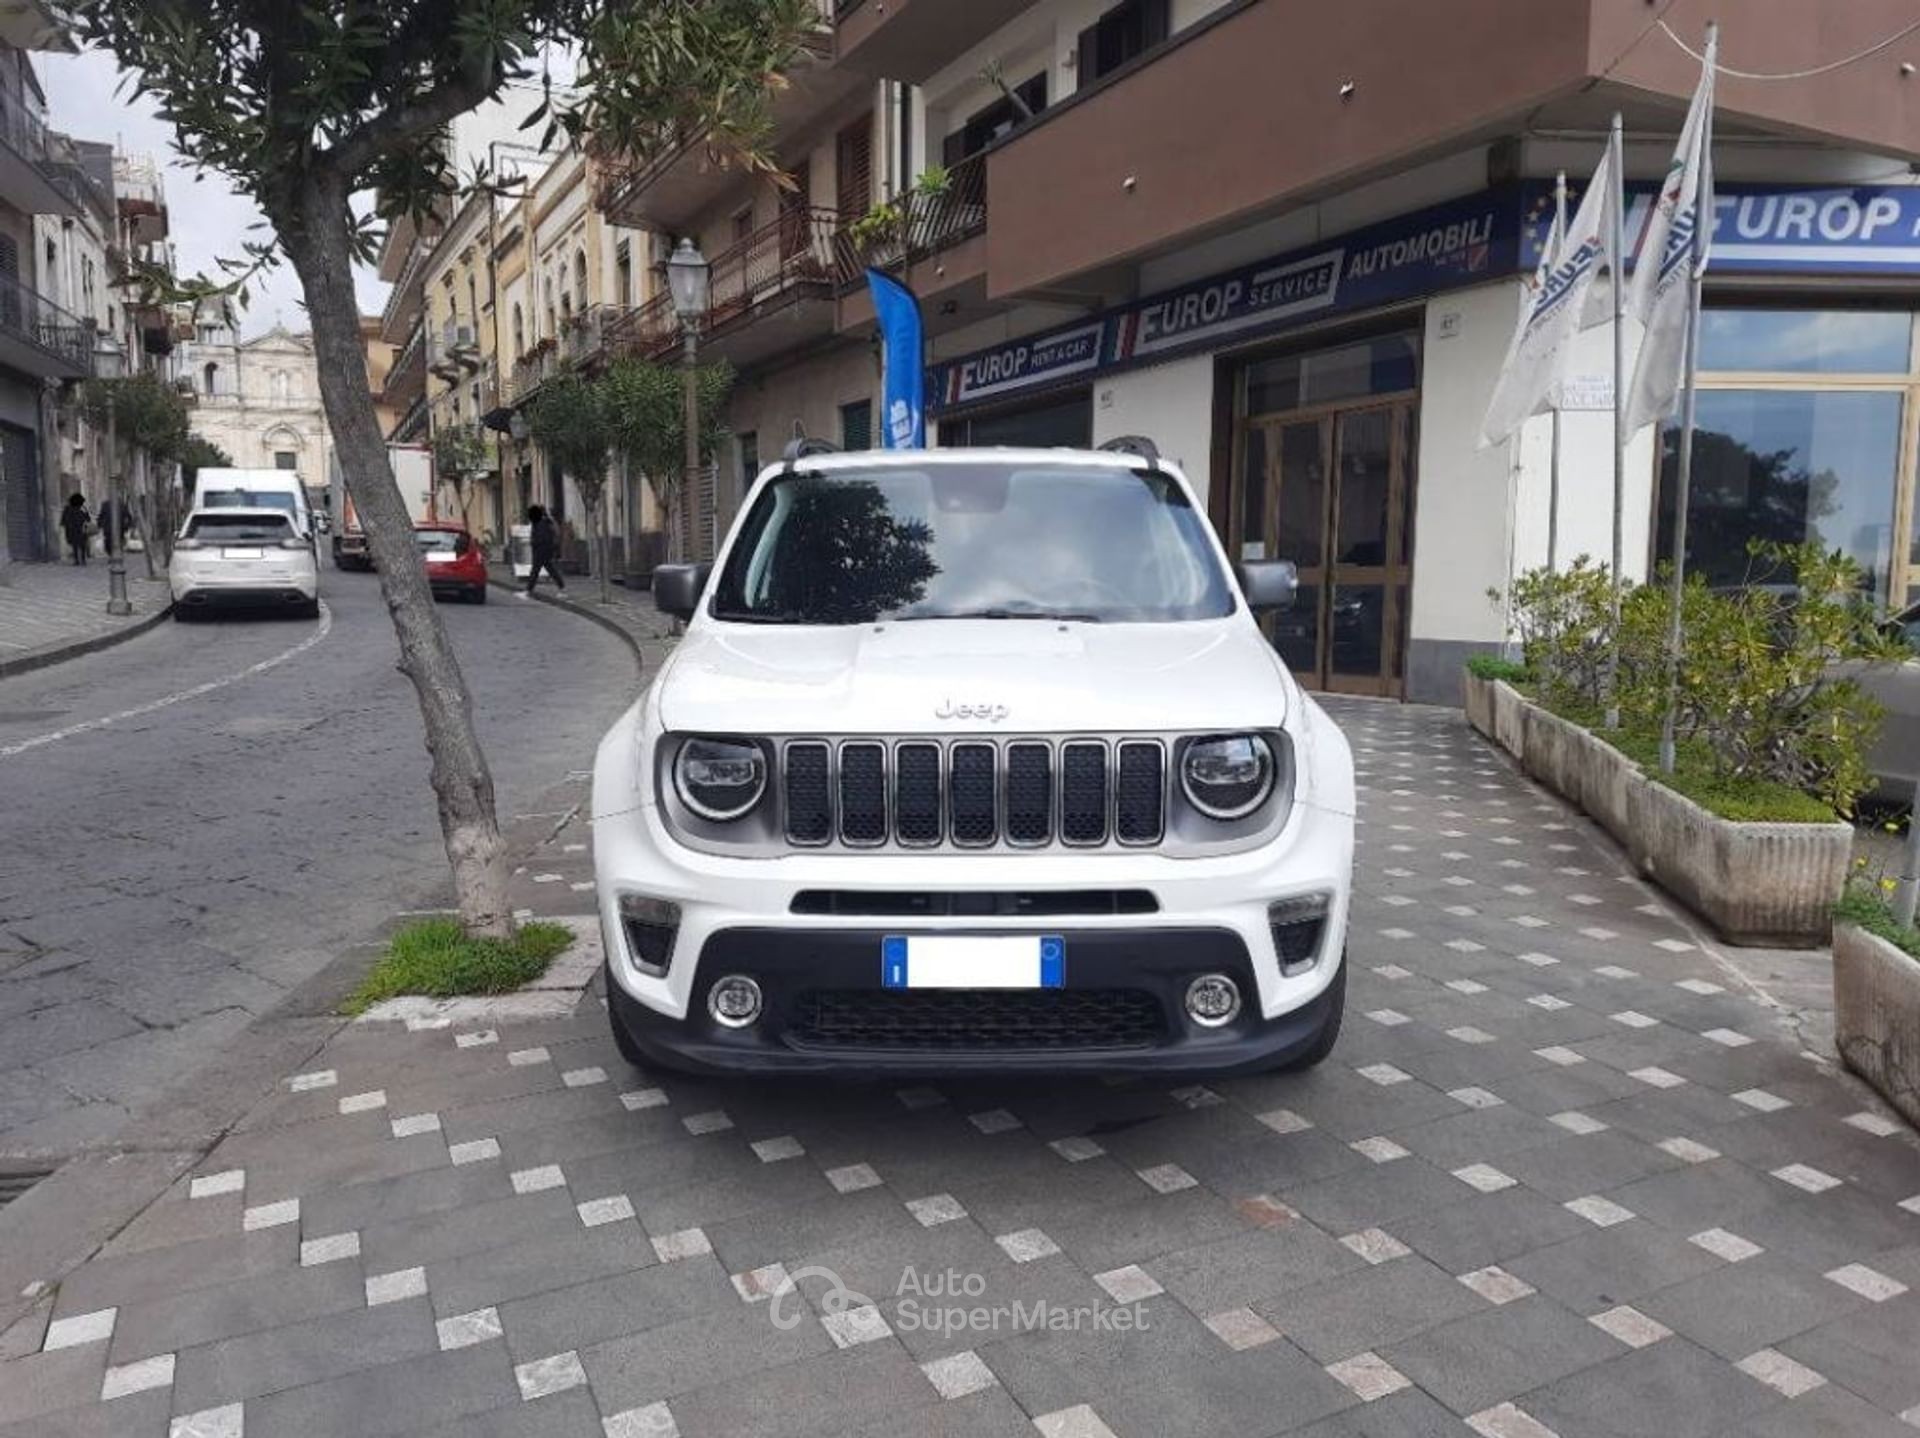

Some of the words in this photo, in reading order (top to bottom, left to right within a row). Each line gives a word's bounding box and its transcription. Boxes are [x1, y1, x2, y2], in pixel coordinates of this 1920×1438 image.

[1347, 212, 1494, 280] AUTOMOBILI
[1138, 279, 1243, 348] EUROP
[1249, 266, 1330, 306] SERVICE
[961, 346, 1028, 393] EUROP
[1030, 349, 1055, 369] RENT
[1056, 349, 1065, 361] A
[1066, 339, 1089, 359] CAR
[935, 698, 1011, 724] Jeep
